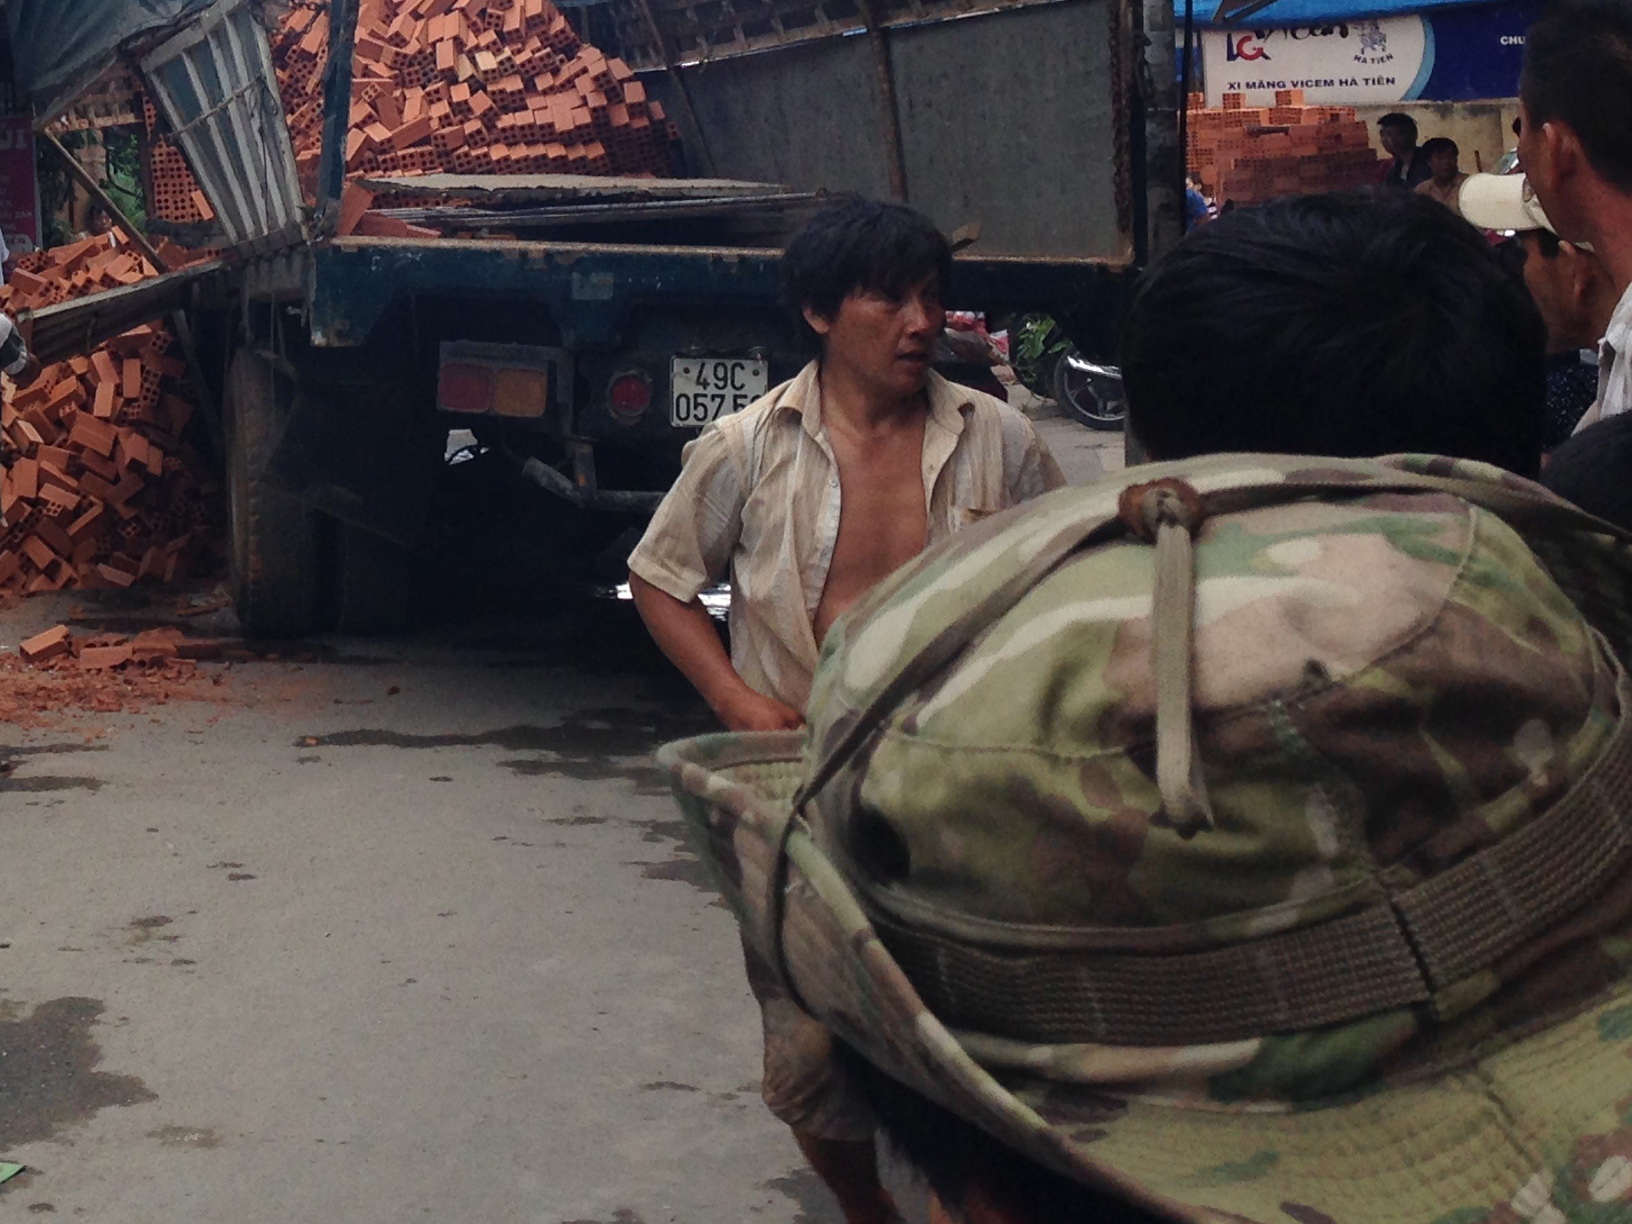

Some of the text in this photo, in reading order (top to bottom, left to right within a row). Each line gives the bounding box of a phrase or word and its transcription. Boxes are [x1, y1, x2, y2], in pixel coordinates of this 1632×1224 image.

[1228, 81, 1241, 90] XI
[1290, 79, 1334, 89] VICEM
[1362, 74, 1396, 86] TIÊN
[695, 361, 746, 391] 49C
